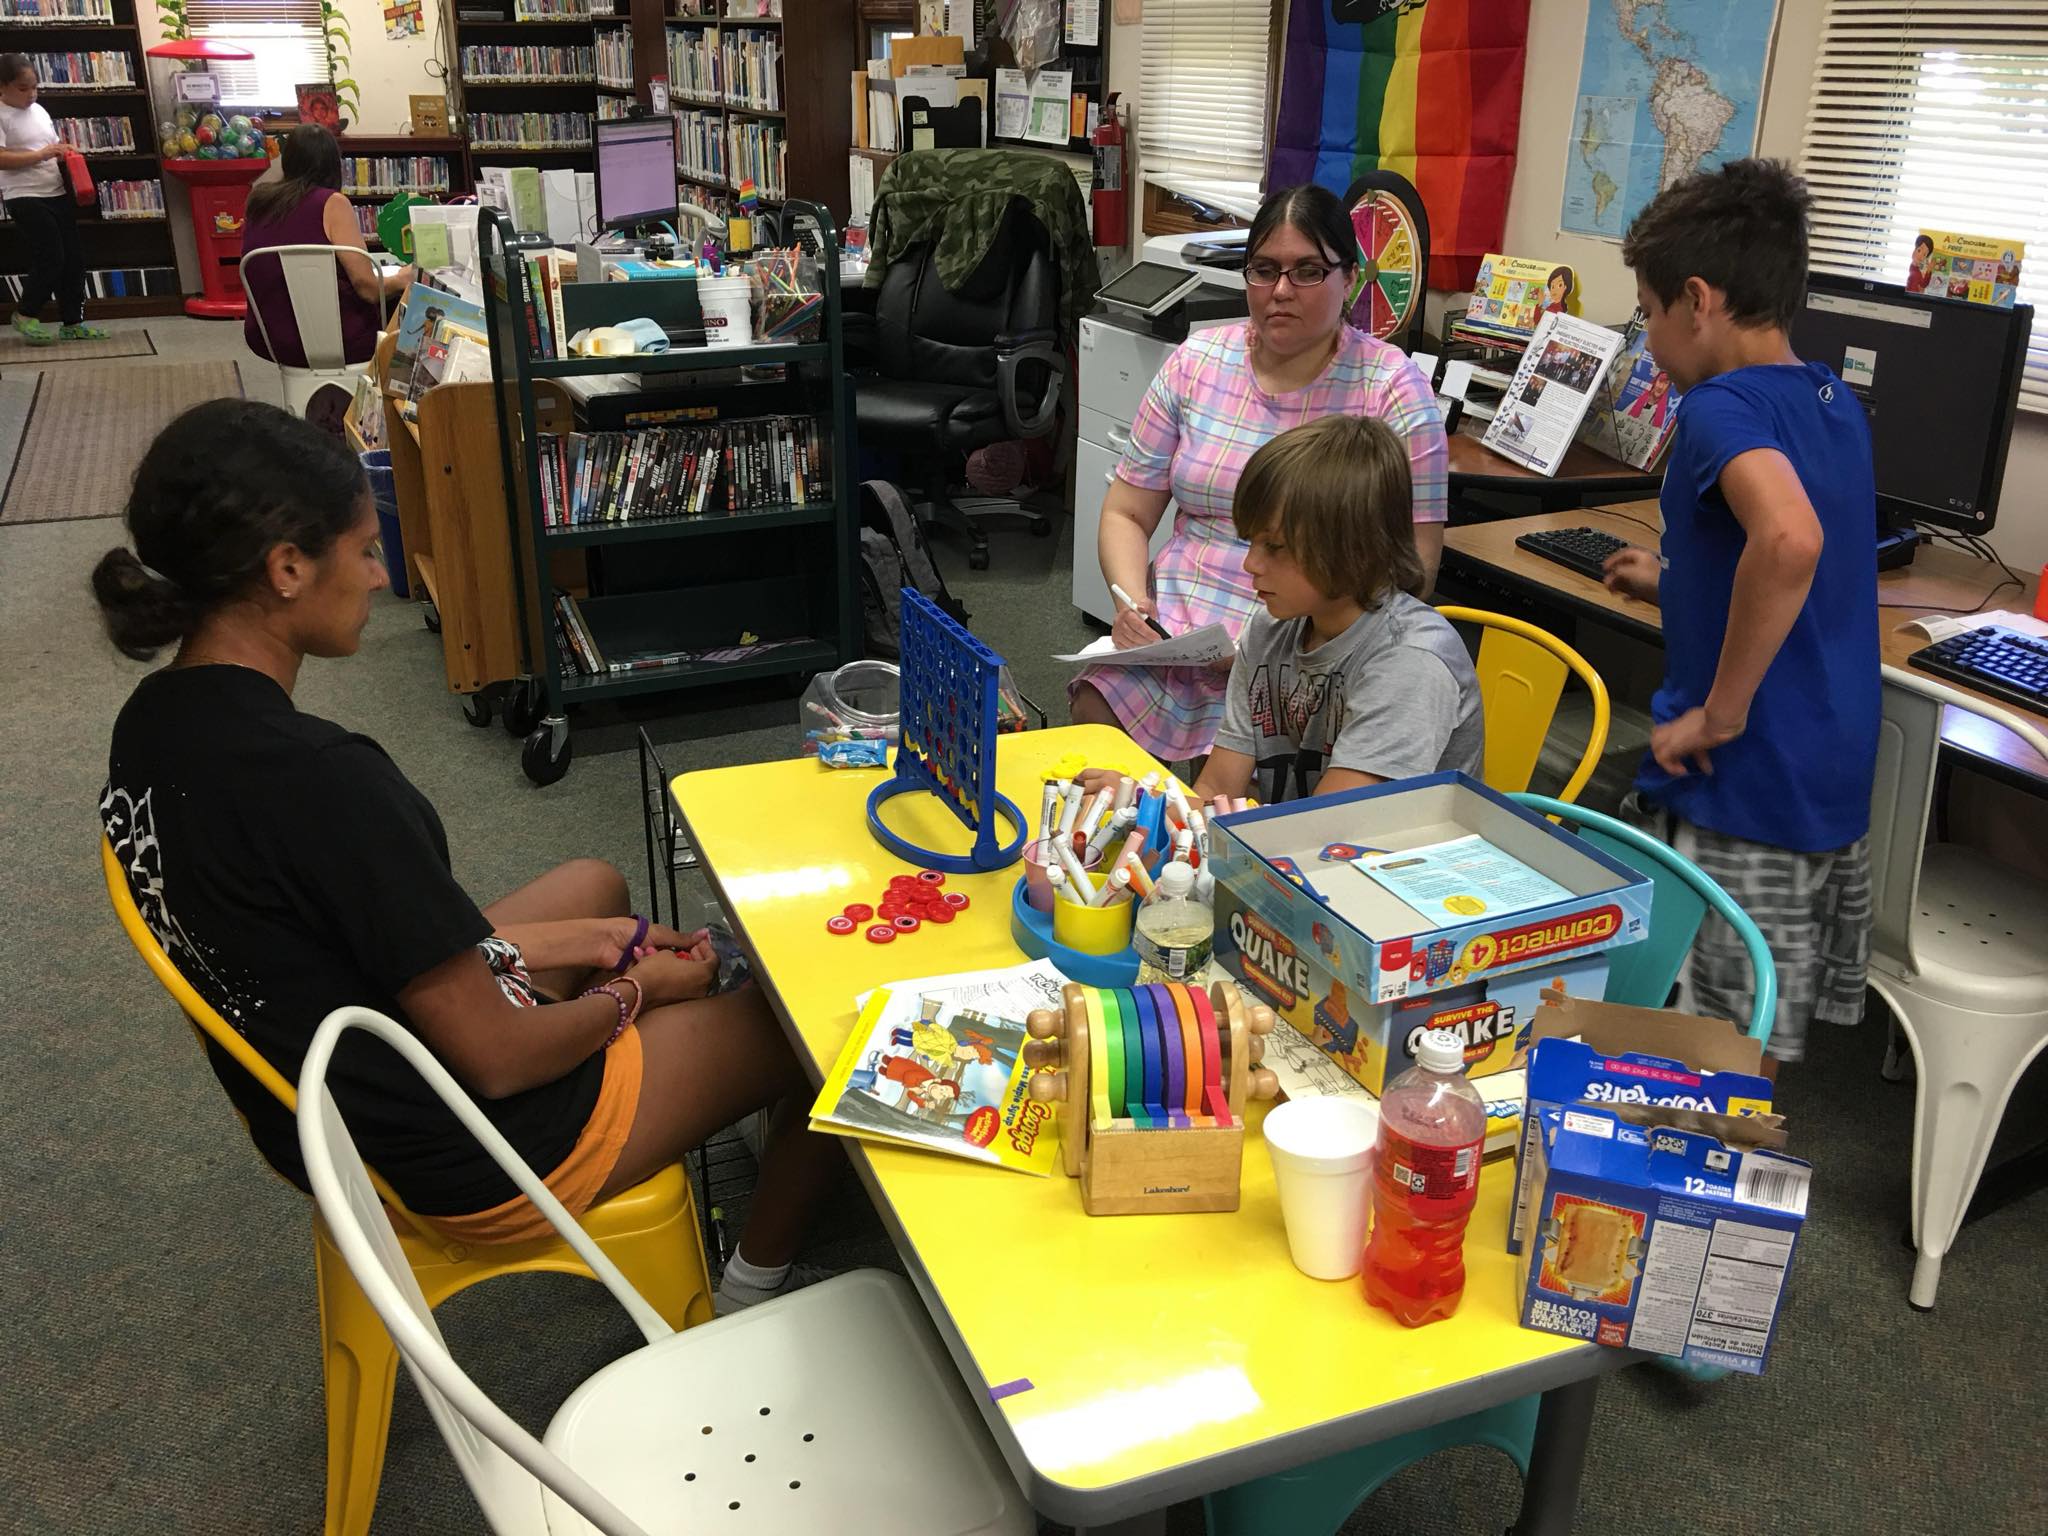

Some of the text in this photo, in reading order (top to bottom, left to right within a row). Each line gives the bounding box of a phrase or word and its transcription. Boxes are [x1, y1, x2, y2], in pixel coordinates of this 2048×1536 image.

[521, 277, 531, 303] IGNATIUS
[709, 449, 722, 482] WAR
[1498, 913, 1614, 961] Connect
[1230, 912, 1310, 998] QUAKE
[1434, 1005, 1495, 1025] SURVIVE THE
[1407, 1008, 1514, 1055] QAKE
[1012, 1080, 1028, 1103] Maple
[1002, 1103, 1021, 1128] Syrup
[1496, 1104, 1521, 1118] GAME
[1008, 1099, 1051, 1156] George
[1684, 1176, 1706, 1196] 12
[1532, 1299, 1599, 1322] TOASTER
[1563, 1315, 1581, 1324] OUT
[1696, 1310, 1714, 1320] 370
[1529, 1318, 1561, 1331] CAN'T
[1561, 1325, 1584, 1336] YOU
[1569, 1322, 1596, 1332] STAND
[1727, 1345, 1762, 1356] Nutrition
[1741, 1342, 1764, 1351] Datos
[1691, 1351, 1738, 1365] VITAMINS
